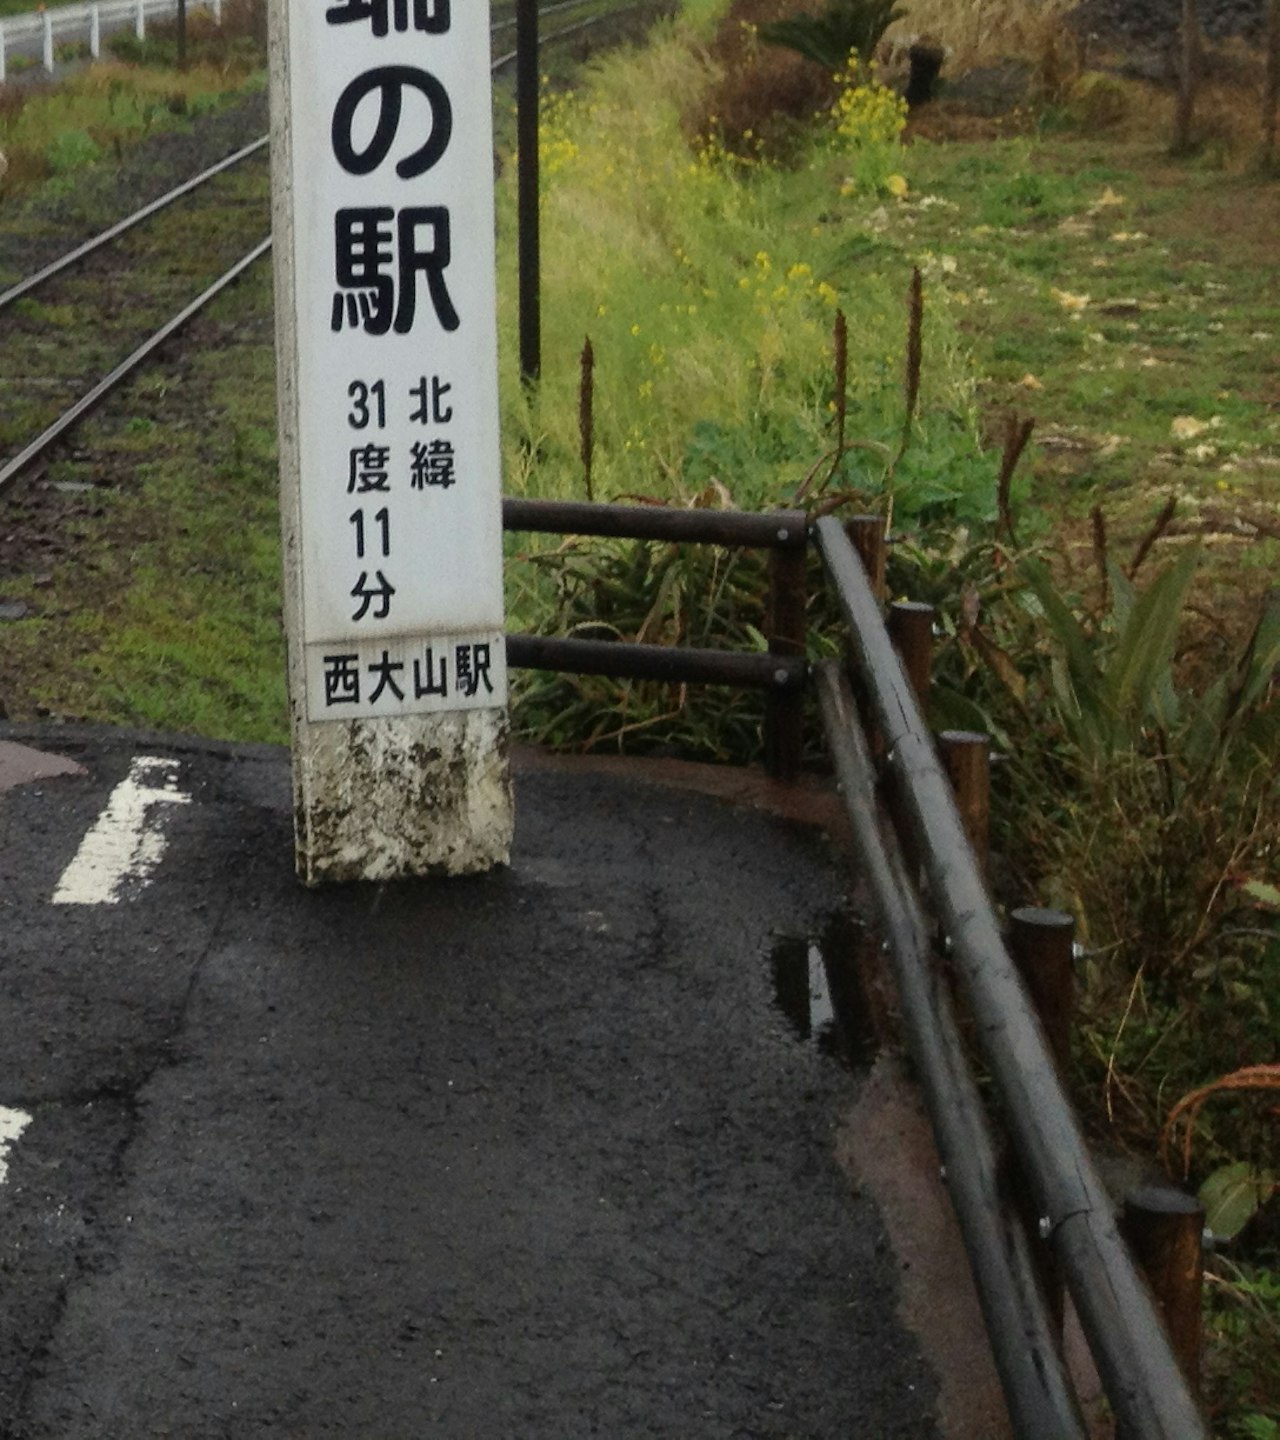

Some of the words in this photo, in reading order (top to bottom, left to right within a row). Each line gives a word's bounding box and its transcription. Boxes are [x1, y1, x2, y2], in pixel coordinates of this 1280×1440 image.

[409, 376, 456, 491] 北緯
[346, 378, 396, 622] 31度11分
[323, 642, 494, 708] 西大山駅
